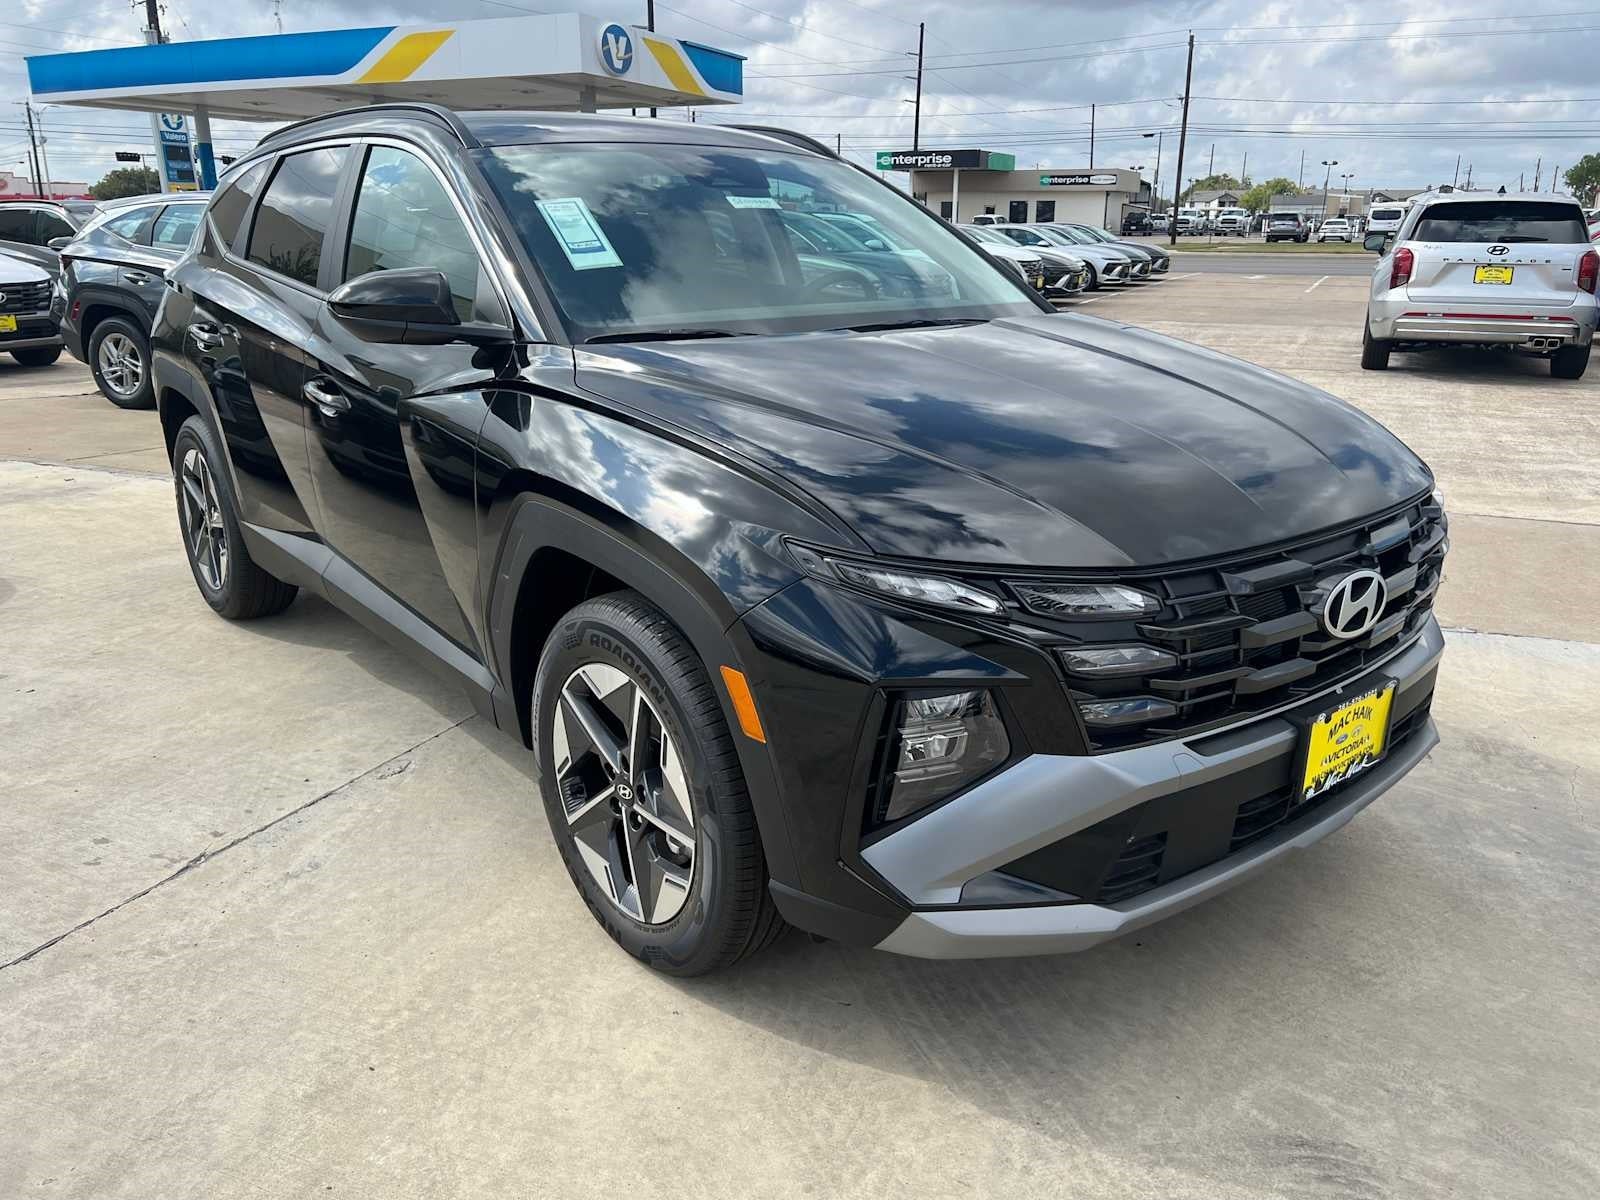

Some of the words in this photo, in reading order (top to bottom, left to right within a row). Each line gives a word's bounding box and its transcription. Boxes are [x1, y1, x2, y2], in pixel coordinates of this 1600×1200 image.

[165, 131, 186, 141] Valero
[879, 153, 952, 166] enterprise
[1041, 176, 1089, 184] enterprise
[1328, 711, 1351, 743] MAC
[1328, 737, 1364, 763] VICTORIA
